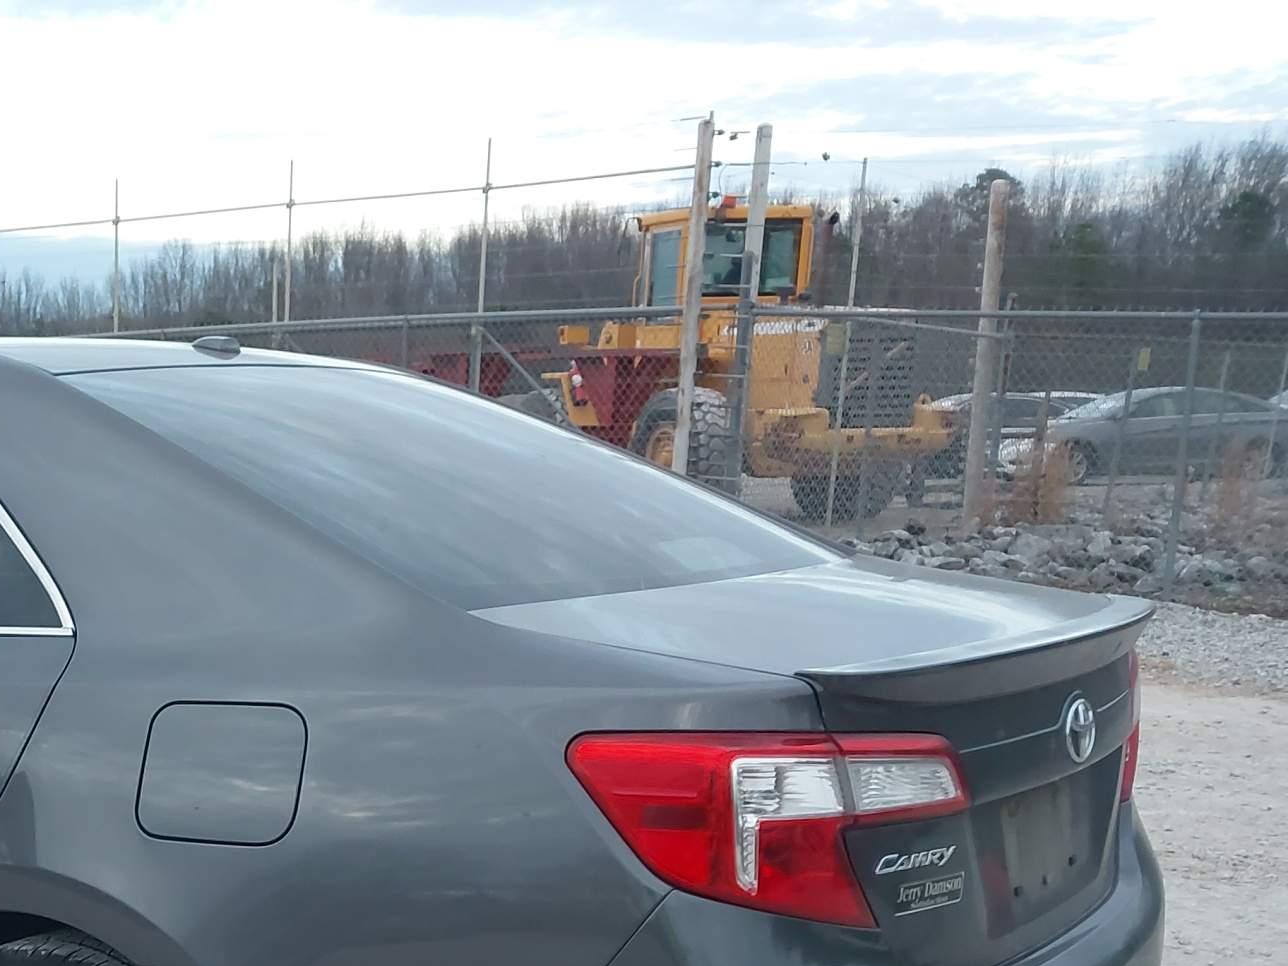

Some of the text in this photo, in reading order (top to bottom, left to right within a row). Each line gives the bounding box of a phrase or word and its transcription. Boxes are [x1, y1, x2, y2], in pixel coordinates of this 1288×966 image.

[875, 845, 956, 874] CAMRY
[897, 887, 922, 904] Jerry
[924, 877, 962, 897] Damson
